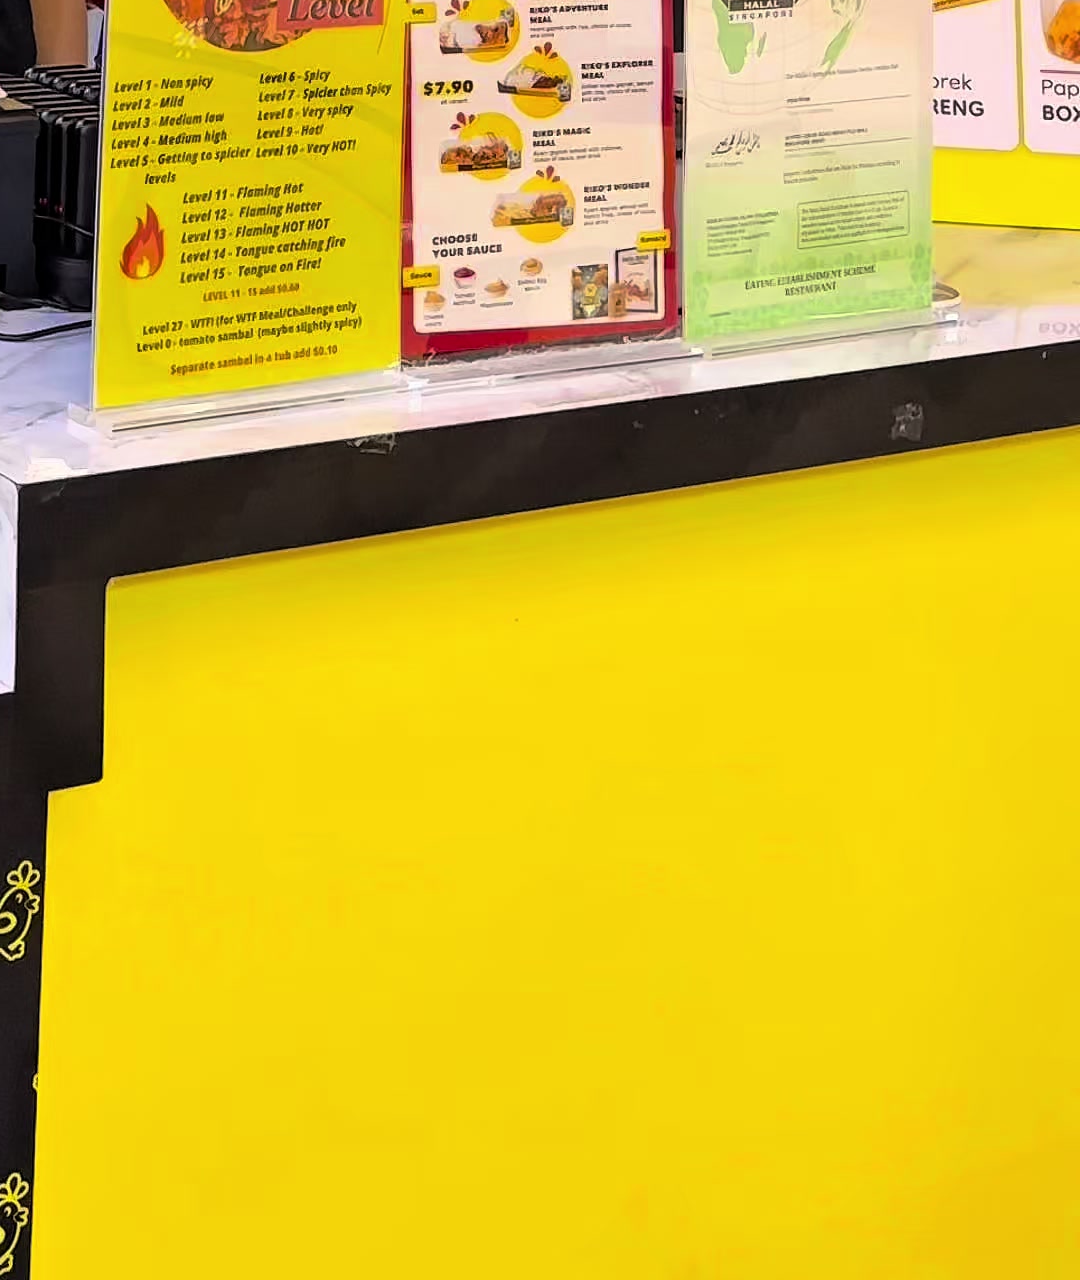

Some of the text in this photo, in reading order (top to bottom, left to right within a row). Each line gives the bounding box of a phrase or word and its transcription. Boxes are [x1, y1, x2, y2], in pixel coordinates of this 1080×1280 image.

[559, 4, 609, 13] ADVENTURE
[743, 0, 780, 10] HALAL
[530, 16, 552, 24] MEAL
[729, 10, 793, 21] SINGAPORE
[113, 75, 213, 93] Level 1 Non spicy
[259, 69, 331, 84] Level 6 Spicy
[581, 72, 604, 80] MEAL
[258, 89, 286, 102] Level
[288, 89, 295, 100] 7
[303, 88, 338, 102] Spicier
[366, 83, 392, 97] Spicy
[423, 79, 473, 96] $7.90
[113, 95, 184, 112] Level 2 Mild
[257, 104, 354, 121] Level Very spicy
[112, 117, 141, 131] Level
[143, 117, 150, 128] 3
[159, 113, 202, 127] Medium
[111, 129, 227, 150] Level 4 Medium high
[257, 126, 284, 139] Level
[286, 126, 293, 137] 9
[563, 127, 591, 135] MAGIC
[110, 146, 251, 168] Level 5 Getting to spicier
[256, 139, 356, 158] Level 10 Very HOT!
[145, 171, 176, 184] levels
[183, 183, 304, 204] Level 11 Flaming Hot
[182, 201, 322, 224] Level 12 Flaming Hotter
[181, 218, 330, 244] Level 13 Flaming HOT HOT
[432, 233, 478, 246] CHOOSE
[180, 236, 346, 264] Level 14 Tongue catching fire
[432, 244, 502, 258] YOUR SAUCE
[180, 258, 322, 284] Level 15 Tongue on Fire!
[410, 271, 432, 280] Sauce
[777, 269, 842, 285] ESTABLISHMENT
[843, 265, 876, 276] SCHEME
[203, 289, 228, 302] LEVEL
[231, 288, 240, 298] 11
[785, 281, 837, 296] RESTAURANT
[142, 321, 169, 336] Level
[171, 320, 183, 332] 27
[236, 312, 257, 323] WTF
[259, 305, 334, 320] Meal/Challenge
[336, 301, 357, 313] only
[137, 339, 163, 352] Level
[165, 338, 172, 349] 0
[217, 328, 254, 342] sambal
[296, 320, 332, 333] slightly
[170, 360, 215, 375] Separate
[217, 354, 253, 368] sambal
[274, 350, 291, 361] tub
[293, 347, 310, 359] add
[313, 344, 338, 357] $0.10
